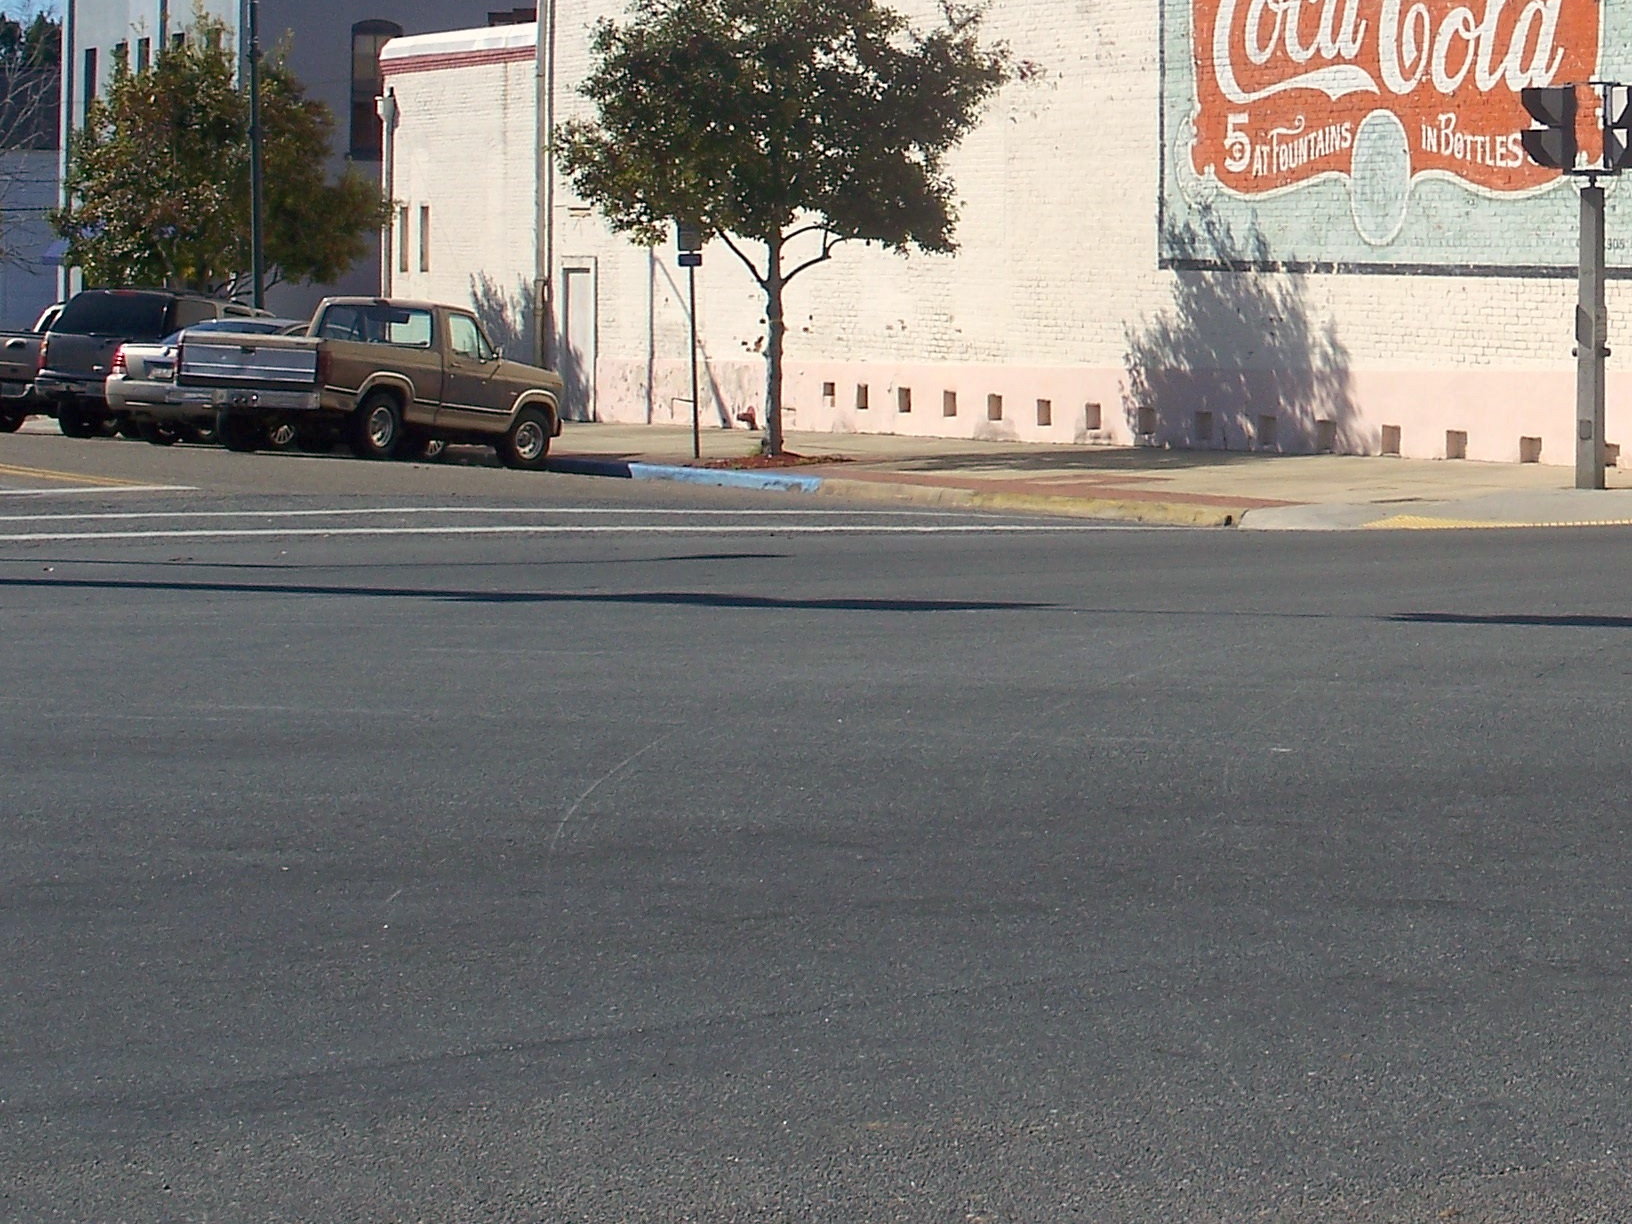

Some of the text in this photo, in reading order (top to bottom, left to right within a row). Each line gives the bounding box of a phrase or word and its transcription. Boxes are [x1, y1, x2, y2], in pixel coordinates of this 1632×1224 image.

[1252, 144, 1270, 179] AT
[1267, 115, 1352, 174] FOUNTAINS
[1421, 123, 1438, 153] IN
[1437, 112, 1524, 168] BOTTLES
